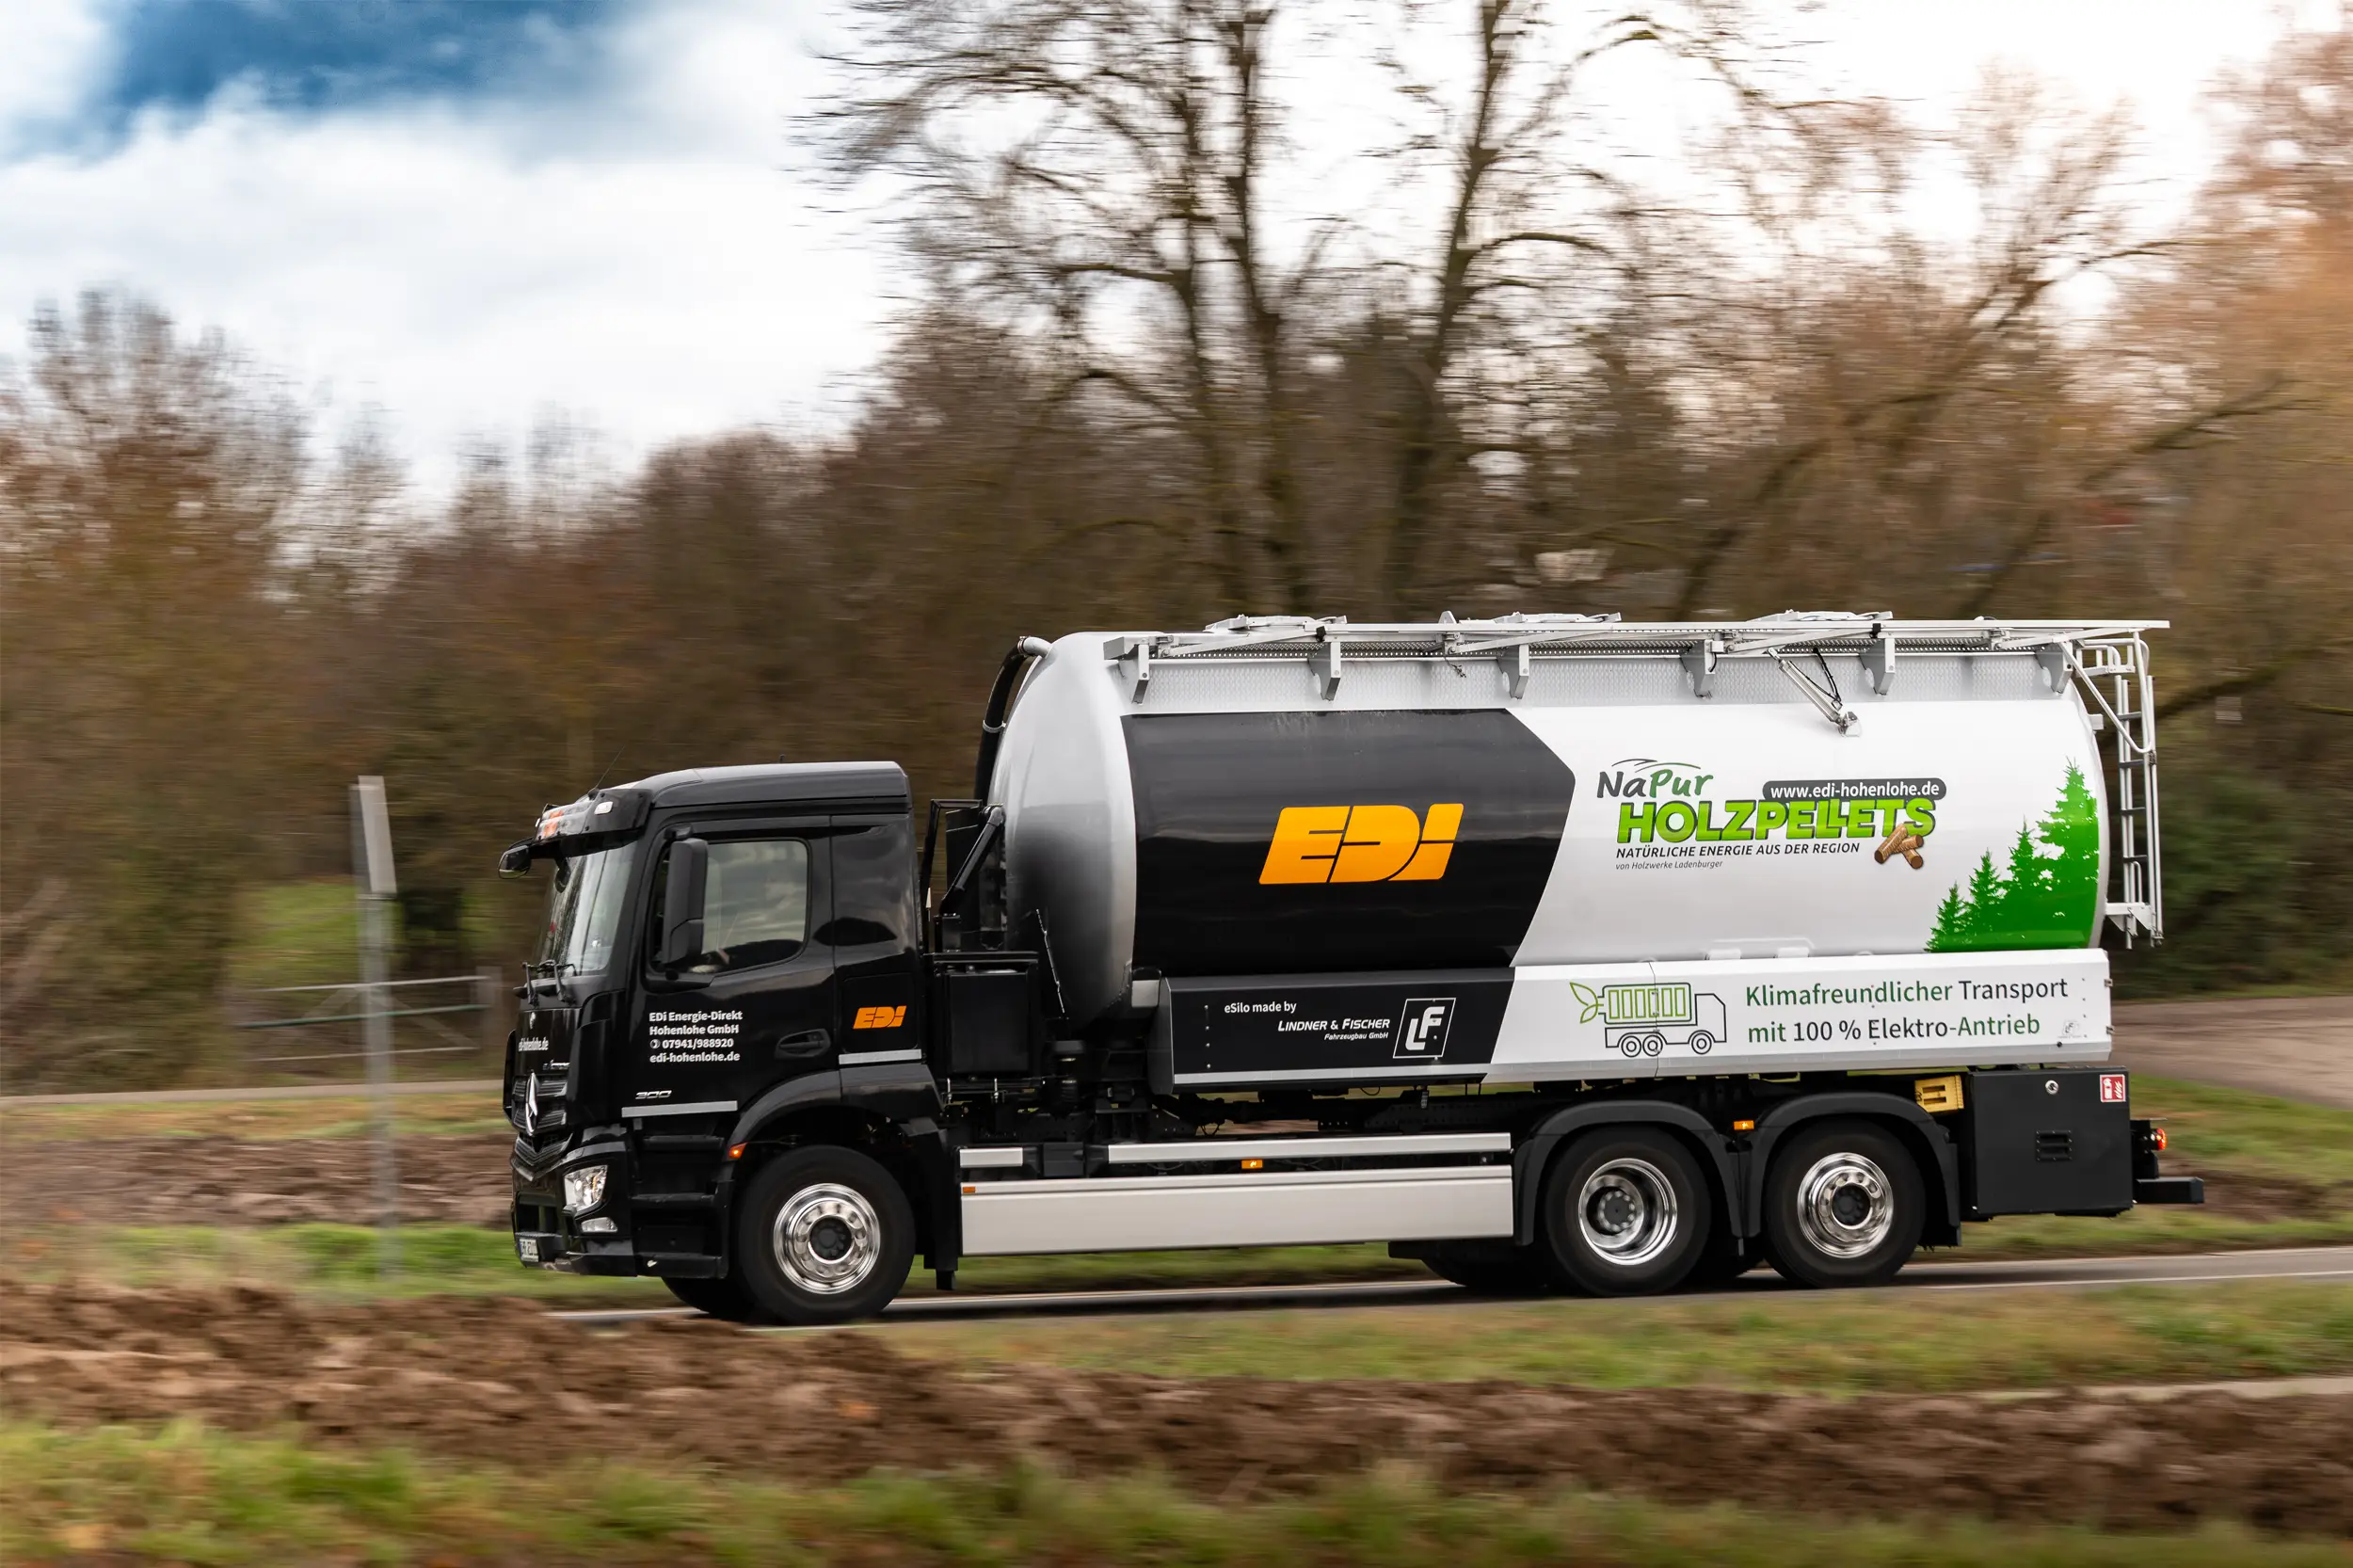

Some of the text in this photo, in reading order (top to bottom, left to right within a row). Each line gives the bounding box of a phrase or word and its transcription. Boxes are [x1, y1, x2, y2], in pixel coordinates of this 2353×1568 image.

[1596, 769, 1714, 798] NaPur
[1770, 781, 1940, 798] www.edi-hohenlohe.de
[1617, 798, 1936, 843] HOLZPELLETS
[1616, 842, 1860, 858] NATÜRLICHE ENERGIE AUS DER REGION
[1631, 861, 1673, 870] Holzwerke
[1674, 859, 1723, 870] Ladenburger
[1746, 978, 2069, 1007] Klimafreundlicher Transport
[1224, 1001, 1297, 1014] eSilo made by
[668, 1011, 743, 1023] Energie-Direkt
[649, 1024, 740, 1035] Hohenlohe GmbH
[1278, 1018, 1390, 1032] LINDNER & FISCHER
[1749, 1014, 2041, 1043] mit 100 % Elektro-Antrieb
[663, 1038, 734, 1049] 07941/988920
[649, 1051, 740, 1063] edi-hohenlohe.de
[635, 1090, 672, 1099] 300
